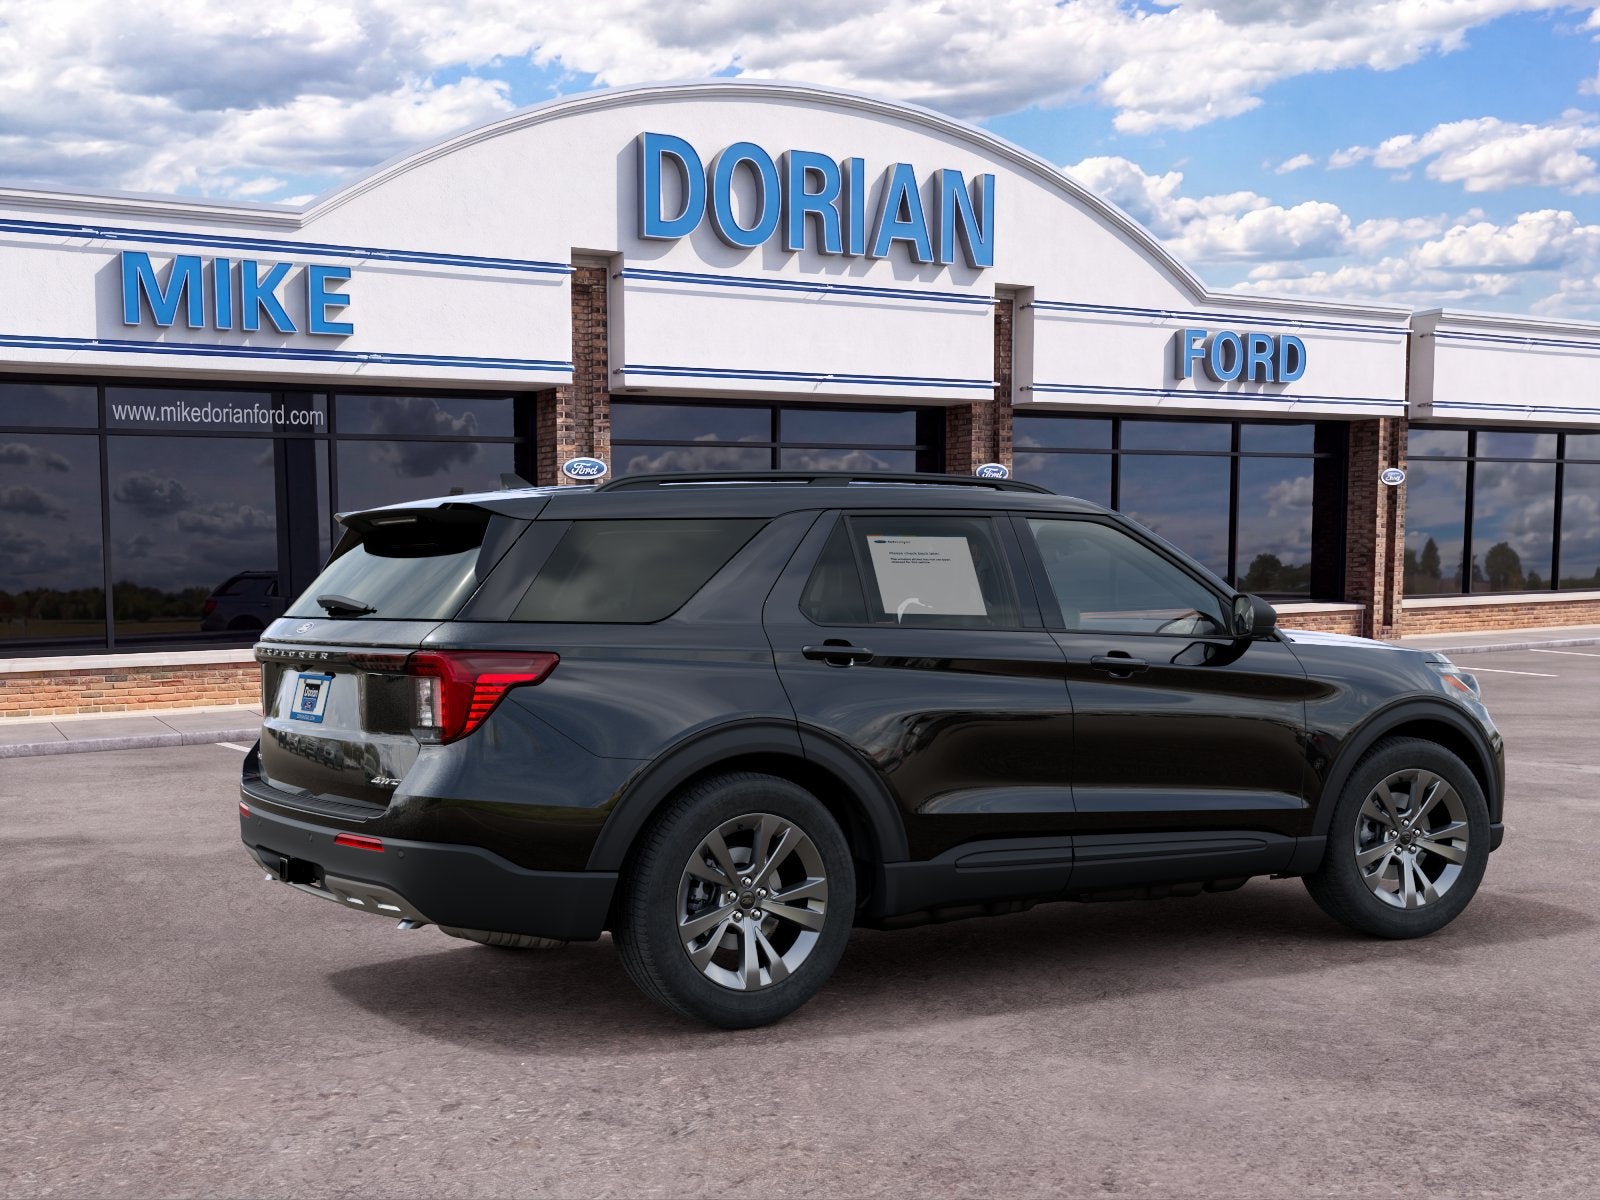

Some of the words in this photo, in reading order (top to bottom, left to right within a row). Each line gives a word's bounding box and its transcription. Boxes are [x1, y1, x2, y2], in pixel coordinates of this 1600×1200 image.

[639, 131, 995, 269] DORIAN
[121, 250, 355, 336] MIKE
[1181, 328, 1307, 383] FORD
[112, 400, 325, 426] www.mikedorianford.com
[571, 462, 599, 475] Ford
[982, 467, 1003, 478] Ford
[260, 648, 329, 660] EXPLORER
